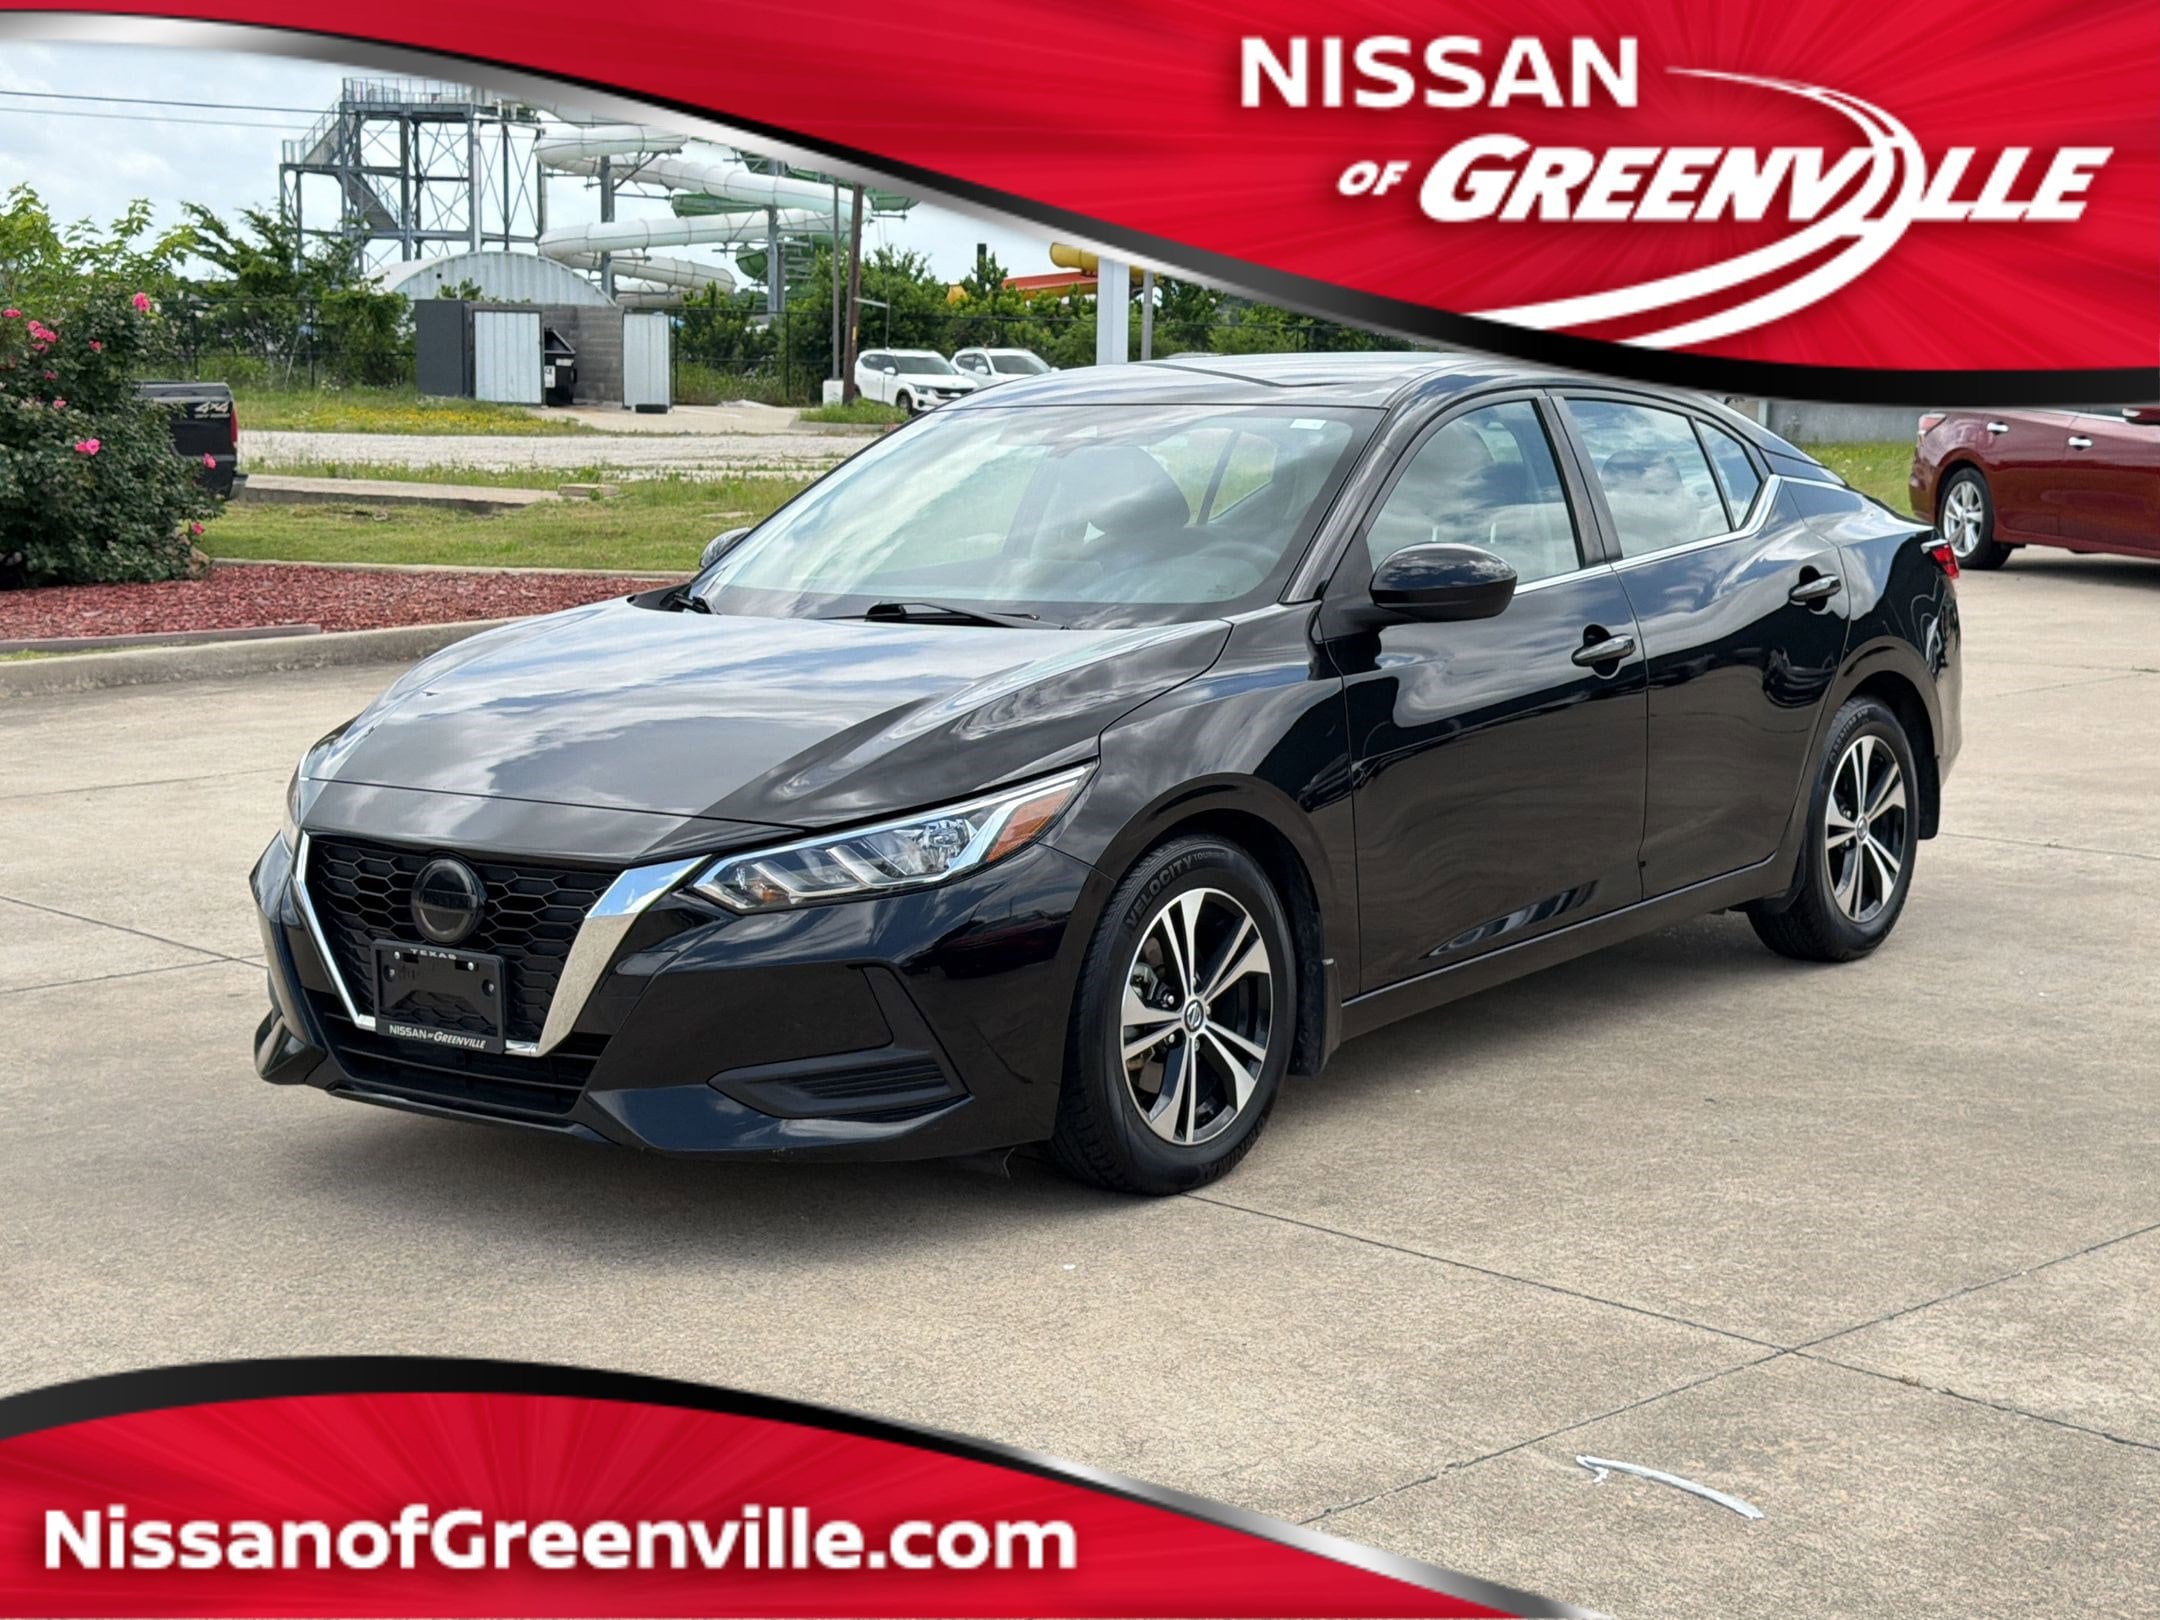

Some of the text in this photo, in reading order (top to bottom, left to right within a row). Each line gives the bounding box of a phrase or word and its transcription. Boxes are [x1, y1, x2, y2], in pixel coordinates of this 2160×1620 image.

[1125, 854, 1193, 927] VELOCITY
[410, 948, 457, 960] TEXAS
[389, 1024, 427, 1039] NISSAN
[433, 1031, 487, 1049] GREENVILLE
